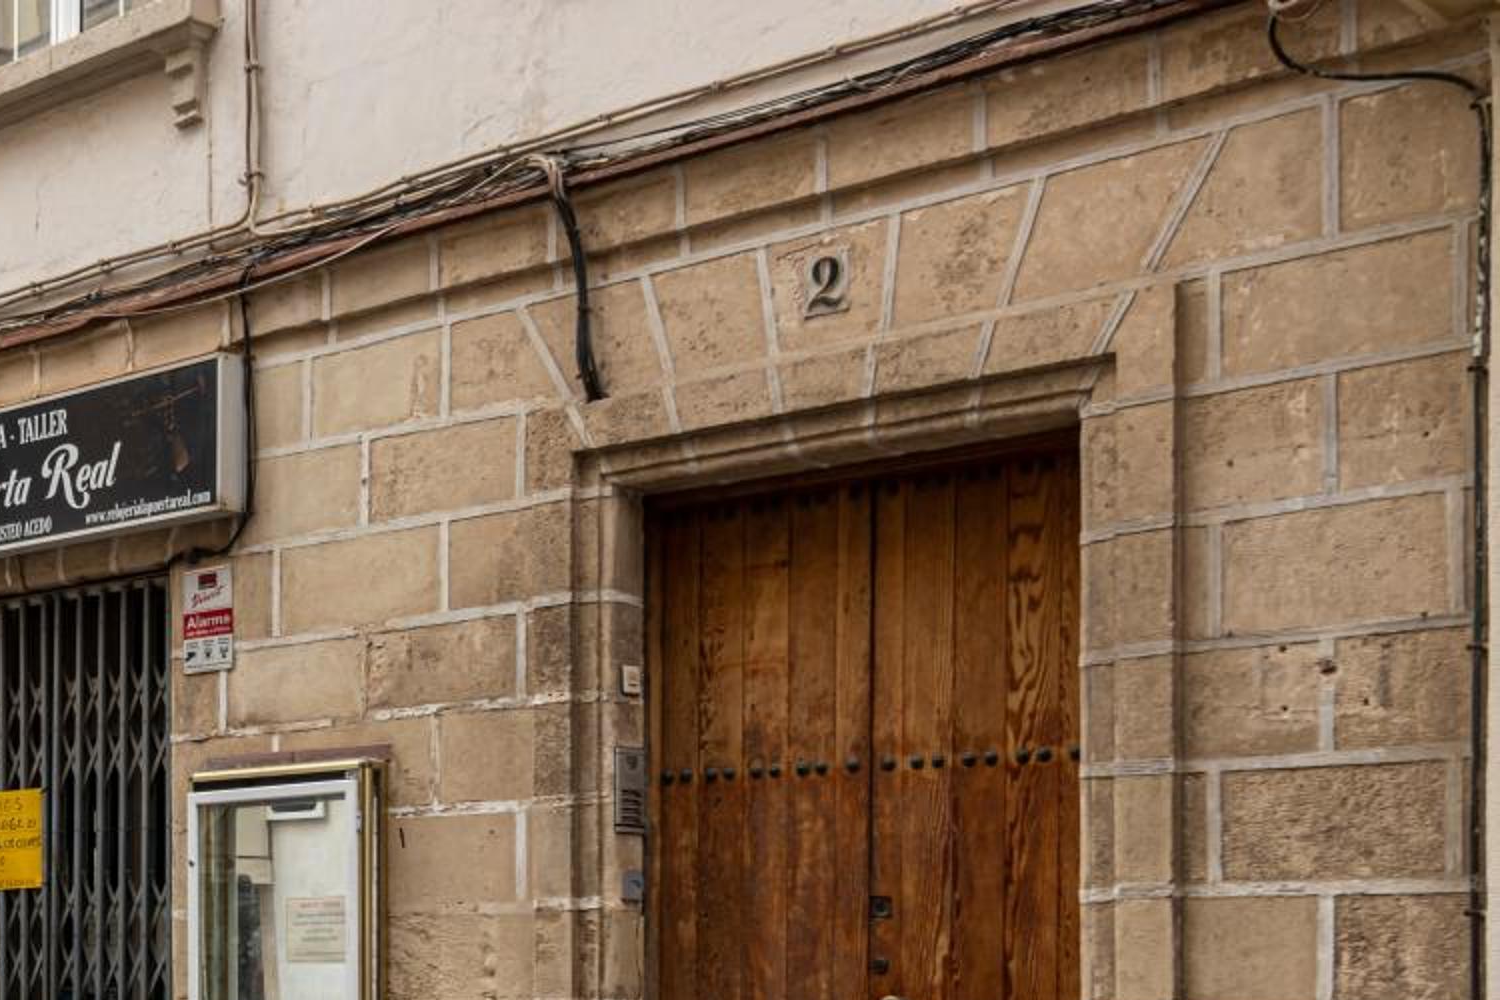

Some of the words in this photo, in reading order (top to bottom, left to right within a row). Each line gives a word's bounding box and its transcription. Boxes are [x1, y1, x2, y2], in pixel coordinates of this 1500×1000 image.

[807, 256, 844, 313] 2
[17, 408, 68, 446] TALLER
[41, 440, 121, 509] Real
[24, 515, 53, 537] ACEDO
